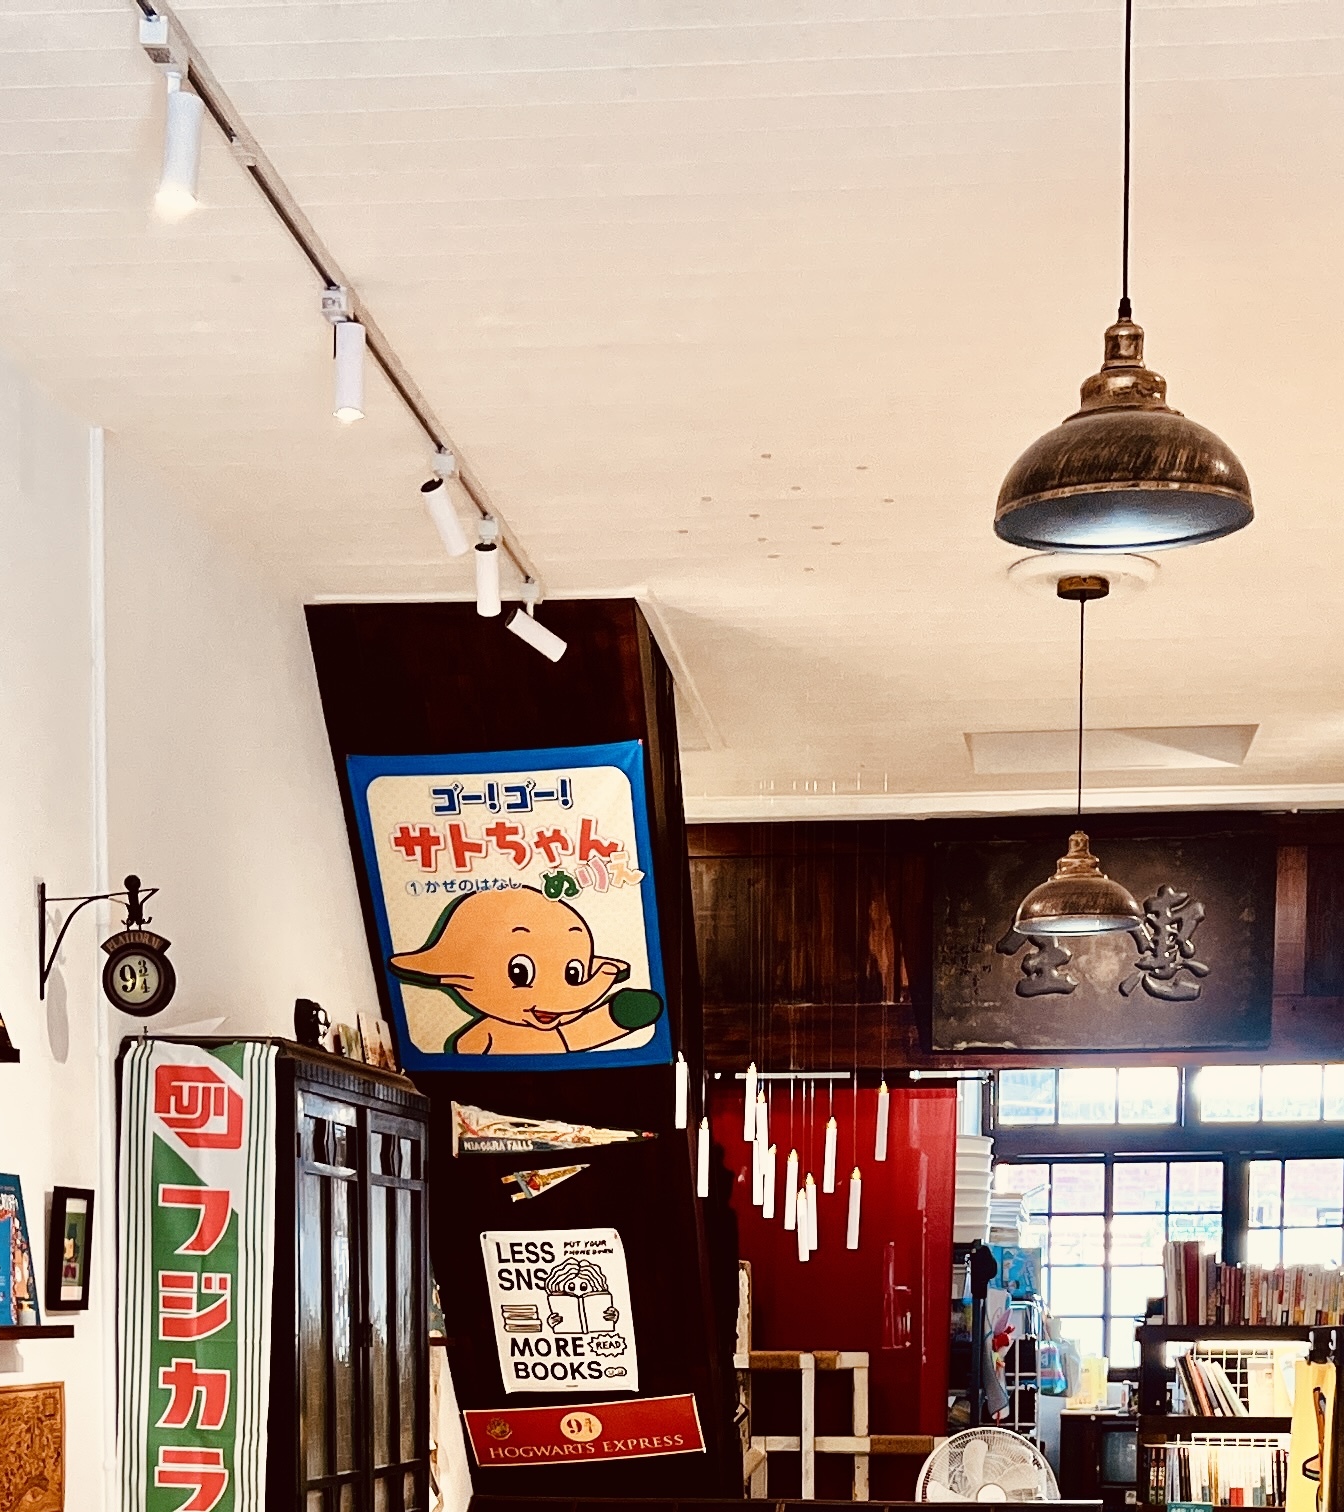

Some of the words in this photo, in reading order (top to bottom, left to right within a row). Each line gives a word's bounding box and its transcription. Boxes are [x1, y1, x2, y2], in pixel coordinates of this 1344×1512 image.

[393, 817, 620, 872] サトちゃん
[463, 1140, 505, 1152] NIAGARA
[507, 1139, 534, 1151] FALLS
[495, 1241, 555, 1264] LESS
[584, 1239, 607, 1248] YOUR
[497, 1268, 548, 1291] SNS
[510, 1337, 585, 1357] MORE
[595, 1339, 621, 1350] READ
[514, 1361, 603, 1381] BOOKS
[489, 1443, 595, 1459] HOGWARTS
[603, 1434, 684, 1453] EXPRESS
